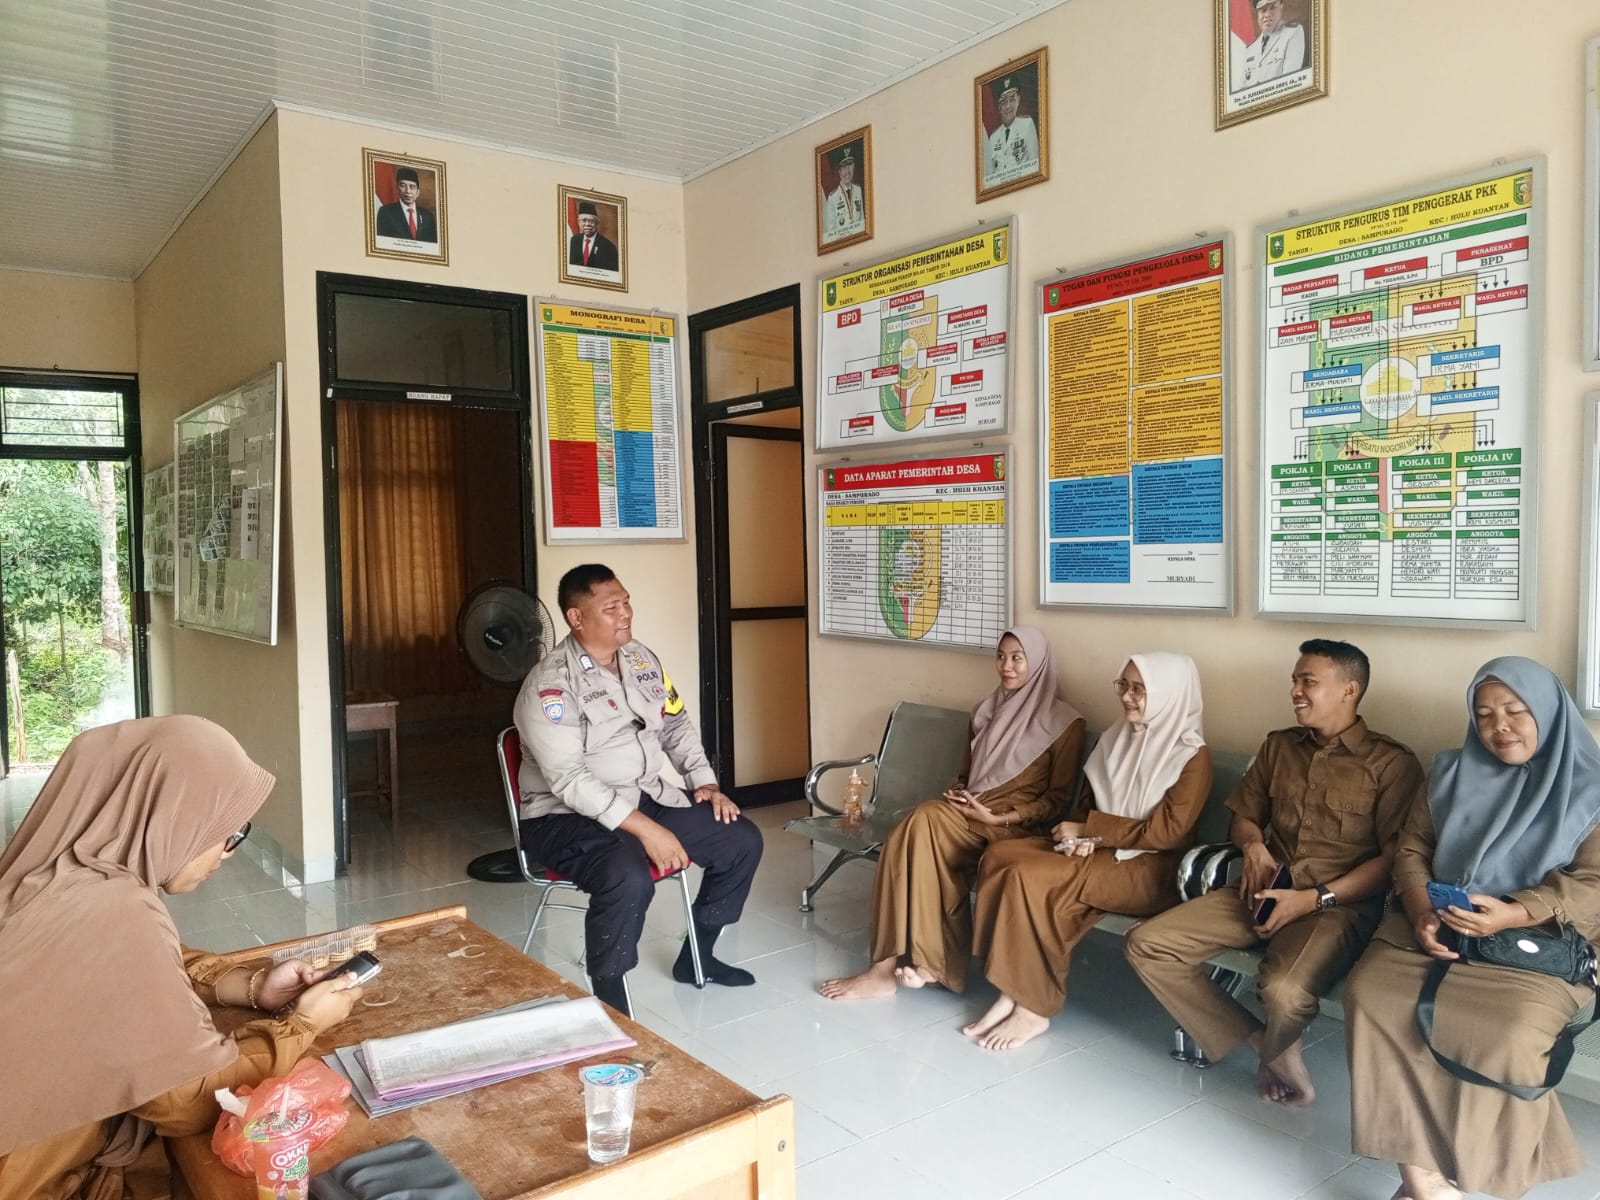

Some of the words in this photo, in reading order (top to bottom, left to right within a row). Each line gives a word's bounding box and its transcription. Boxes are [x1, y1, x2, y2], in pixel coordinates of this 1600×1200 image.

[1296, 222, 1342, 241] STRUKTUR
[1343, 210, 1389, 229] PENGURUS
[1392, 205, 1409, 218] TIM
[1412, 191, 1472, 214] PENGGERAK
[1476, 184, 1497, 201] PKK
[1429, 217, 1444, 226] KEC
[1450, 212, 1471, 221] HULU
[1472, 202, 1509, 216] KUANTAN
[1338, 236, 1356, 246] DESA
[1361, 227, 1403, 241] SAMPURAGO
[1288, 247, 1308, 256] TAHUN
[1334, 248, 1369, 262] BIDANG
[1372, 232, 1450, 254] PEMERINTAHAN
[1471, 243, 1513, 255] PENASEHAT
[842, 272, 873, 288] STRUKTUR
[874, 262, 911, 280] ORGANISASI
[912, 245, 964, 268] PEMERINTAHAN
[966, 239, 985, 253] DESA
[1481, 256, 1504, 266] BPD
[1062, 281, 1085, 292] TUGAS
[1087, 278, 1101, 286] DAN
[1103, 270, 1131, 282] FUNGSI
[1133, 258, 1180, 276] PENGELOLA
[1182, 253, 1204, 264] DESA
[1384, 264, 1406, 273] KETUA
[1283, 283, 1302, 292] BADAN
[570, 310, 622, 322] MONOGRAFI
[841, 311, 857, 325] BPD
[1441, 350, 1484, 361] SEKRETARIS
[1455, 390, 1498, 398] SEKRETARIS
[1464, 455, 1498, 463] POKJA
[844, 471, 864, 483] DATA
[866, 469, 896, 481] APARAT
[898, 466, 954, 478] PEMERINTAH
[956, 464, 980, 474] DESA
[637, 671, 658, 683] POLRI
